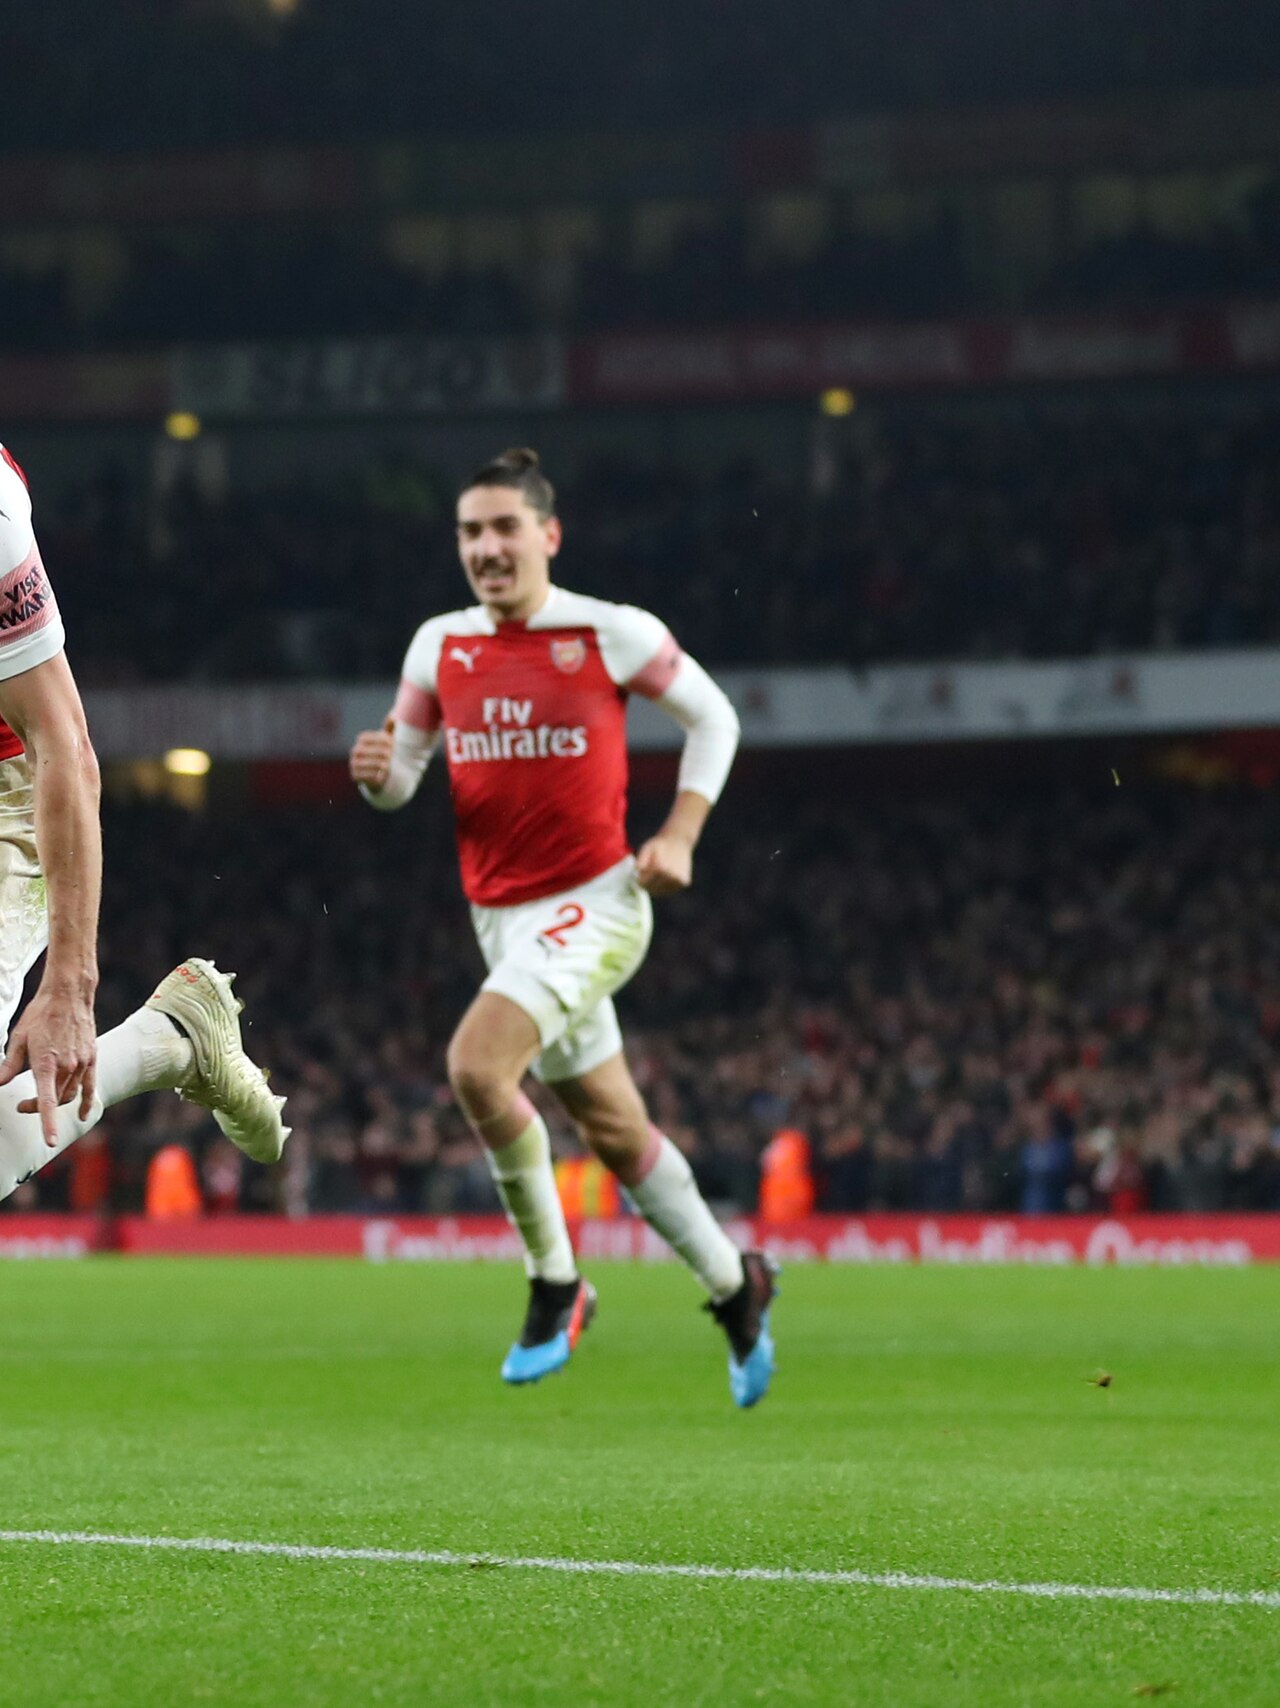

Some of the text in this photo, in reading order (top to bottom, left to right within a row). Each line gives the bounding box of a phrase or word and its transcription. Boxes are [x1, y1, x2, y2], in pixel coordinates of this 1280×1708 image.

[4, 566, 42, 604] VISIT
[483, 697, 533, 728] Fly
[447, 724, 588, 764] Emirates
[542, 903, 585, 948] 2
